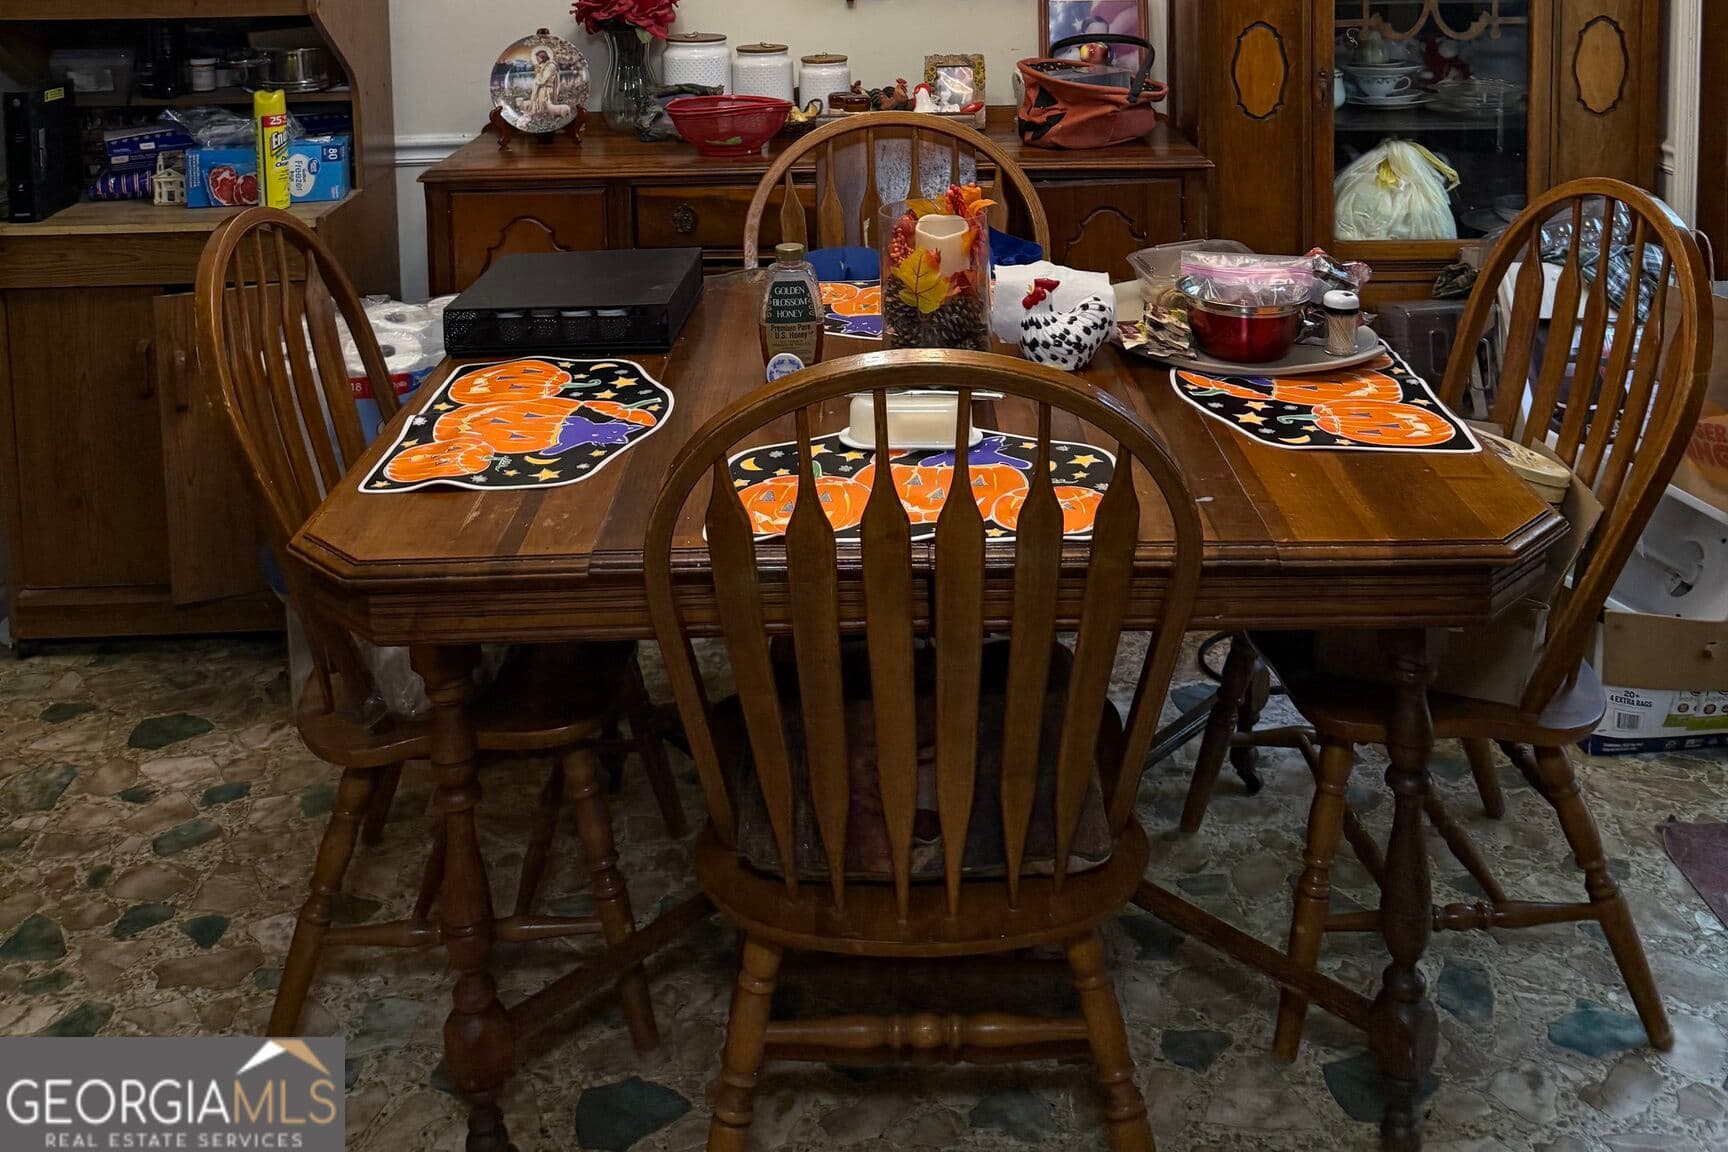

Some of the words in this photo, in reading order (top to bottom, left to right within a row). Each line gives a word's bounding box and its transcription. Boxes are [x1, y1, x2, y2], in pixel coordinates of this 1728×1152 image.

[328, 147, 338, 160] 80
[774, 286, 805, 295] GOLDEN
[772, 298, 808, 307] BLOSSOM
[776, 310, 803, 319] HONEY
[770, 324, 797, 332] Premium
[789, 331, 808, 341] Honey
[351, 382, 362, 392] 18
[1609, 694, 1615, 702] 4
[1615, 696, 1635, 707] EXTRA
[1636, 699, 1653, 708] BAGS
